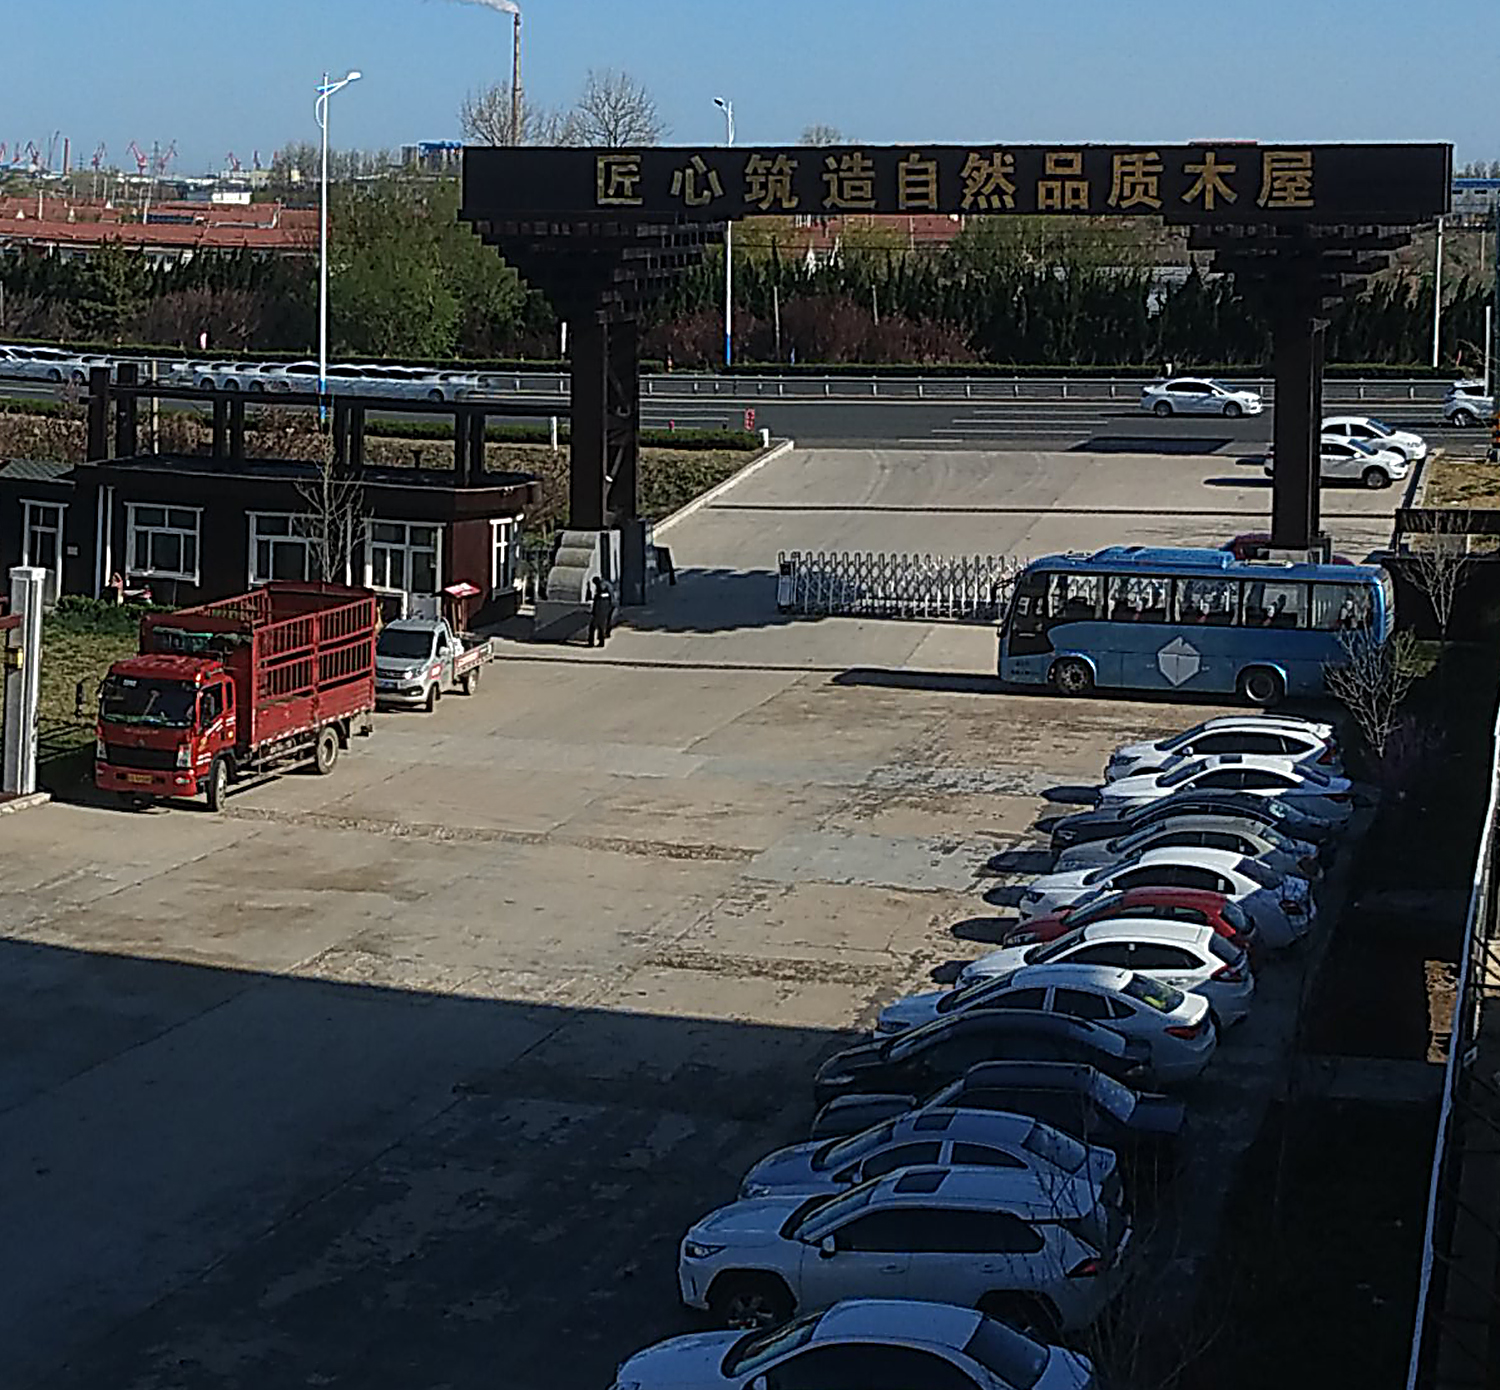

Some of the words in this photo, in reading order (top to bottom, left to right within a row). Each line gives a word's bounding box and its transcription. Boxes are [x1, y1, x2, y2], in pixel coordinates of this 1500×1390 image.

[597, 152, 1316, 210] 匠心筑造自然品质木屋
